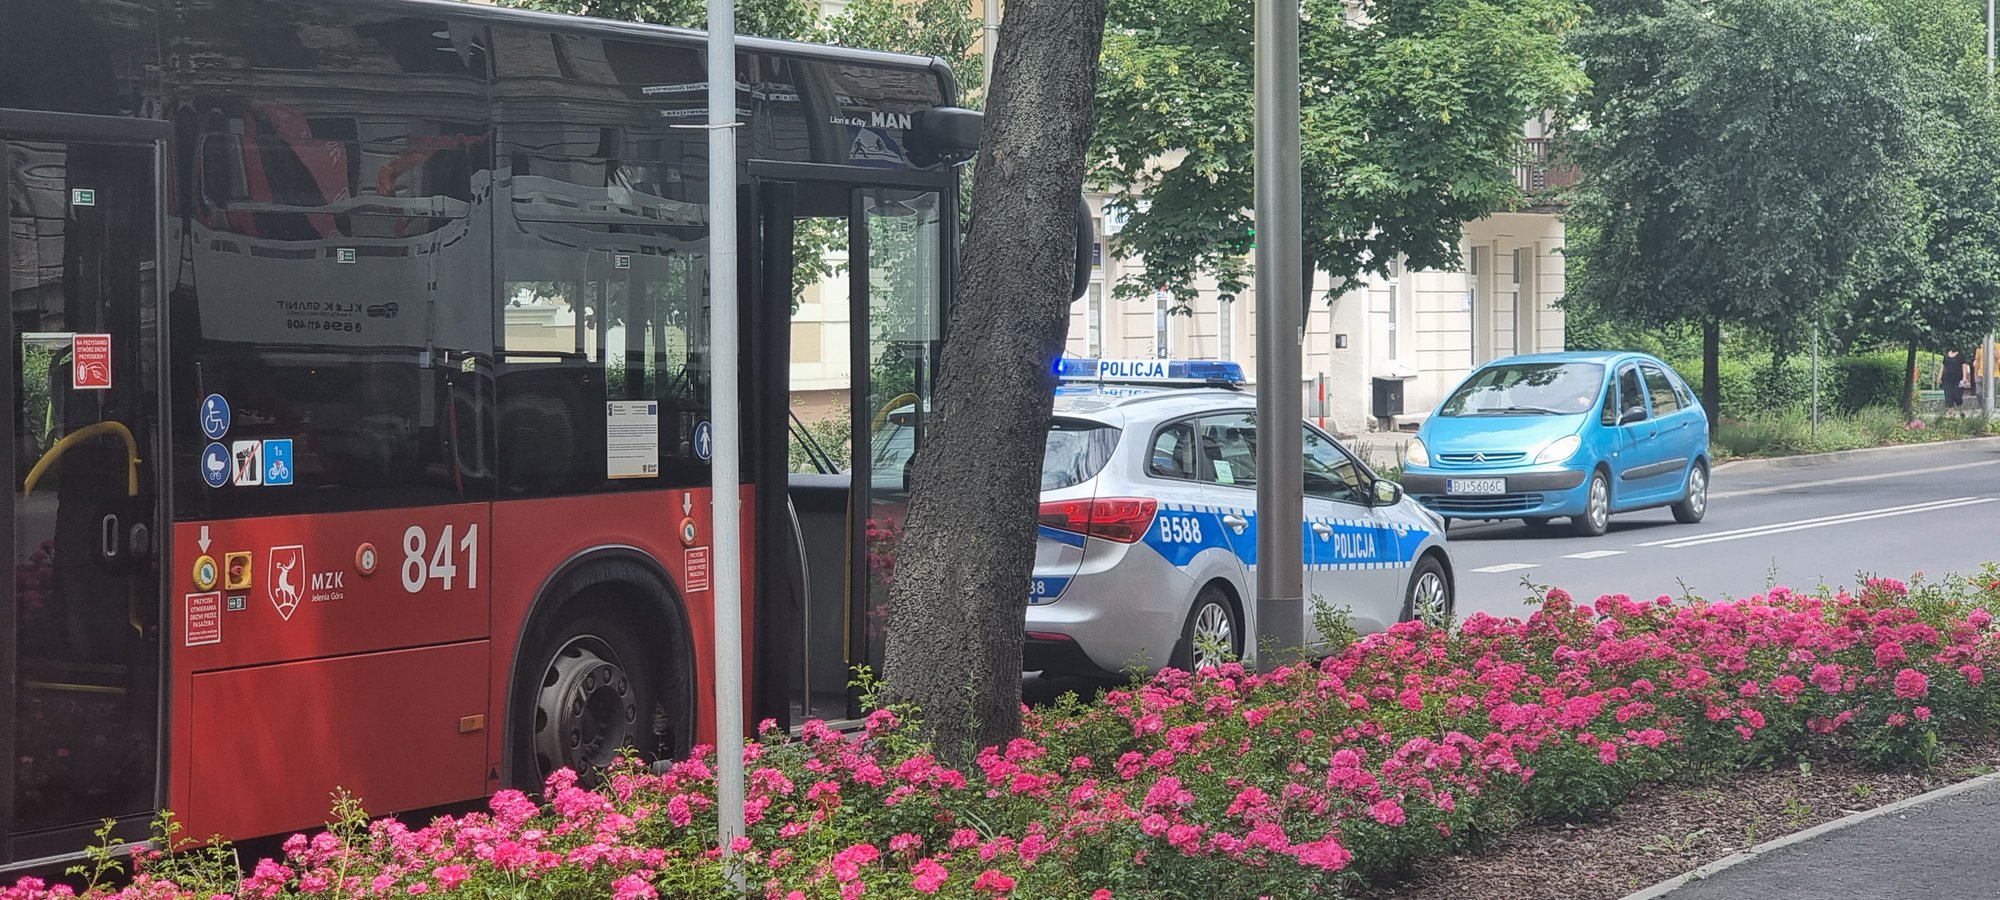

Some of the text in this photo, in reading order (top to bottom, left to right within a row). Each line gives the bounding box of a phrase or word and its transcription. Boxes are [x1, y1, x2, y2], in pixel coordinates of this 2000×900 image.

[830, 111, 912, 130] Lion's City MAN
[1100, 361, 1164, 378] POLICJA
[274, 445, 283, 457] 1x
[1159, 516, 1202, 544] B588
[1334, 533, 1376, 560] POLICJA
[401, 523, 478, 594] 841
[311, 571, 344, 591] MZK
[311, 591, 344, 602] Jelenia Góra
